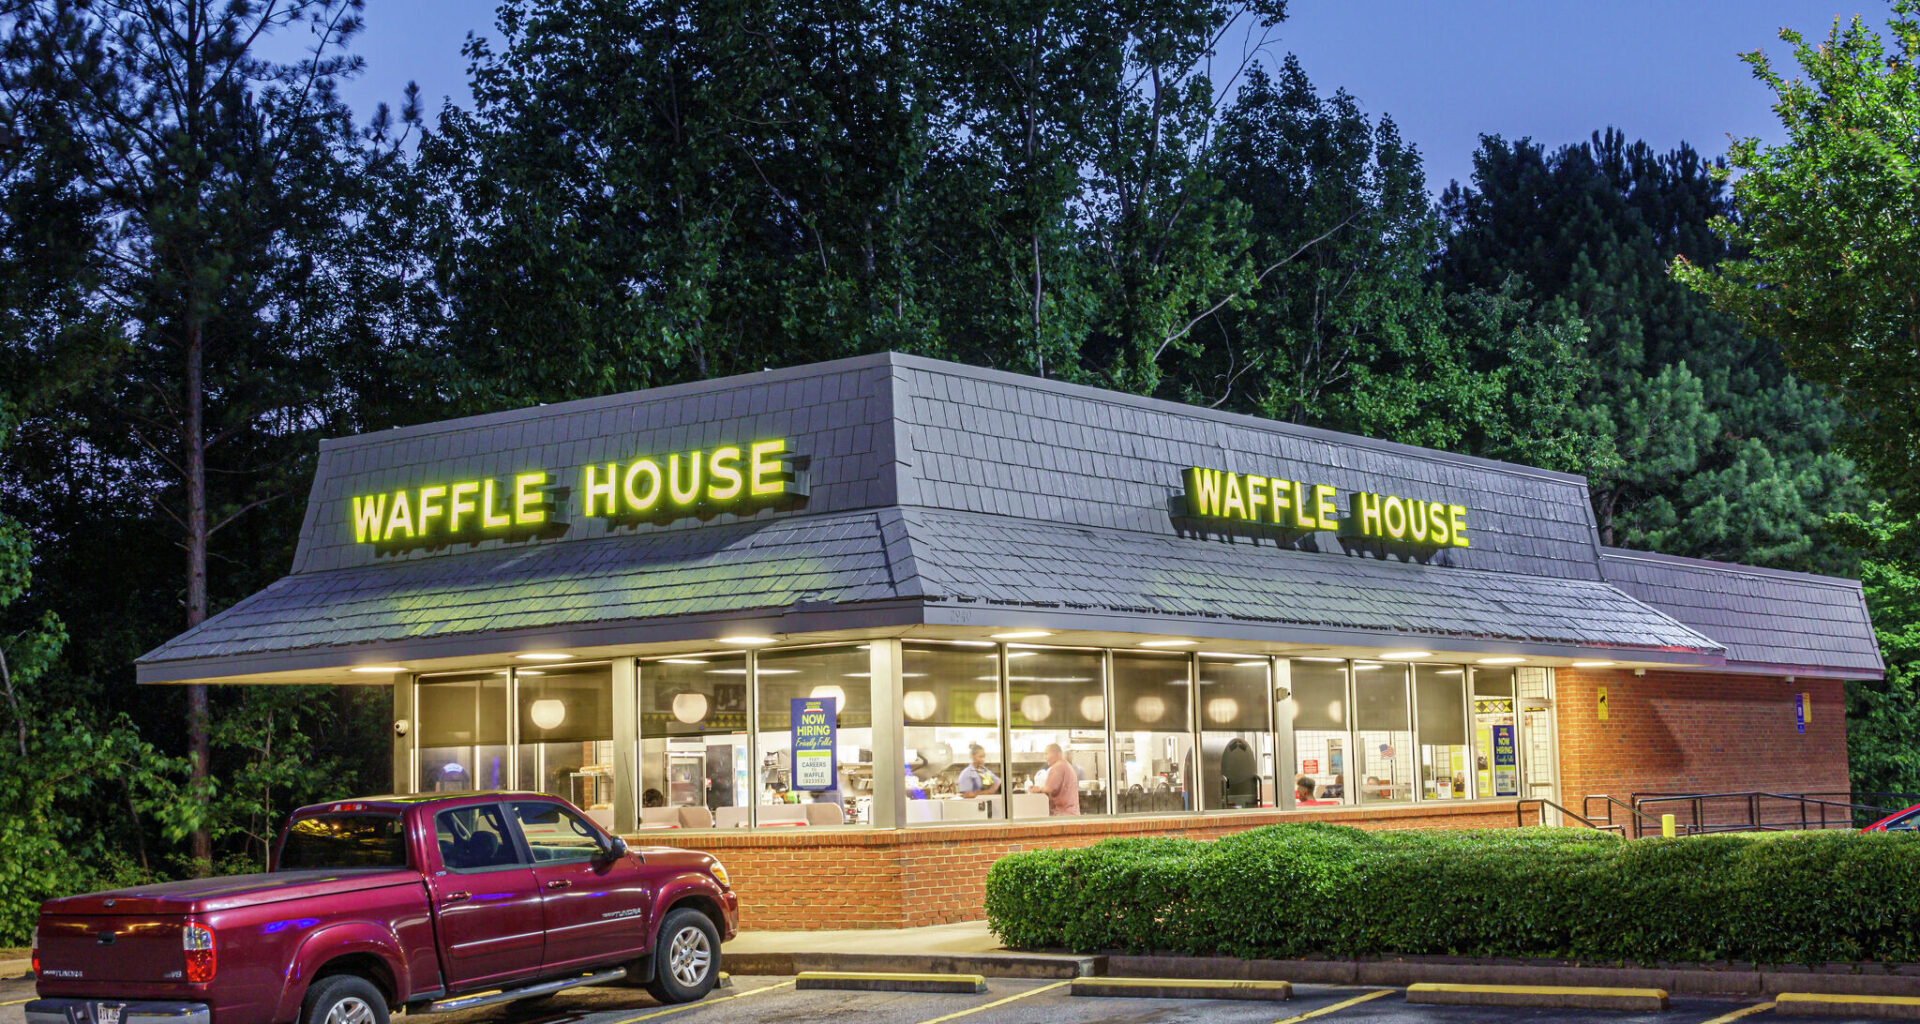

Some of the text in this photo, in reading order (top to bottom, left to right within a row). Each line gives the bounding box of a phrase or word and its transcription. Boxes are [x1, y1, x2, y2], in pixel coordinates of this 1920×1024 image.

[353, 439, 785, 543] WAFFLE HOUSE
[1192, 466, 1469, 547] WAFFLE HOUSE
[801, 713, 825, 725] NOW
[796, 725, 830, 736] HIRING
[1498, 737, 1510, 745] NOW
